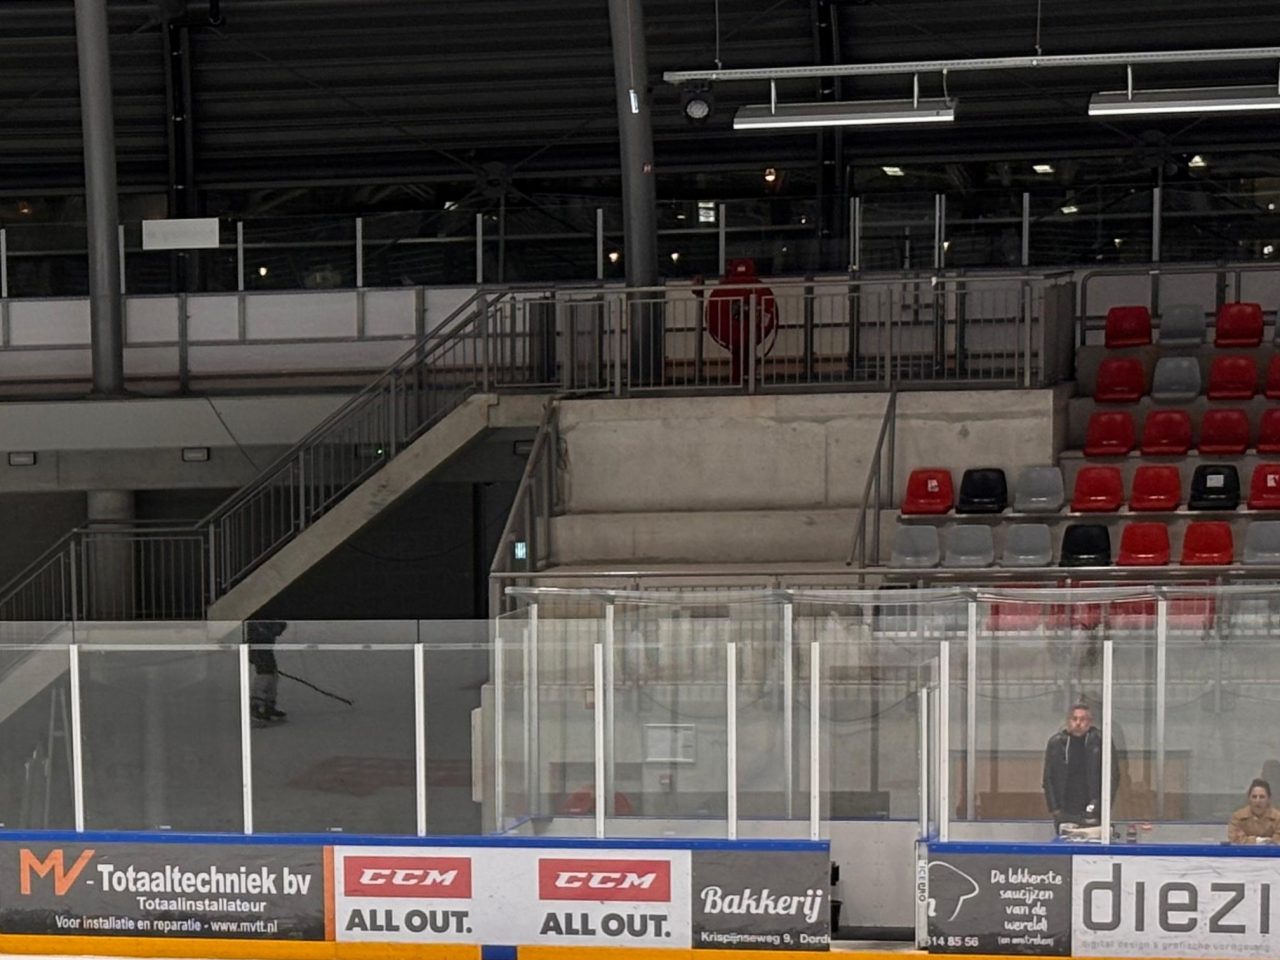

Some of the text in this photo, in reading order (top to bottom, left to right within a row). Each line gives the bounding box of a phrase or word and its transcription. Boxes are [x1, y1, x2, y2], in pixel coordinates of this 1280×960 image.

[97, 864, 277, 894] Totaaltechniek
[282, 867, 311, 895] bv
[359, 868, 459, 886] CCM
[555, 871, 657, 889] CCM
[991, 867, 1062, 885] De lekkerste
[136, 896, 267, 912] Totaalinstallateur
[1000, 886, 1053, 904] saucijzen
[700, 886, 823, 923] Bakkerij
[1005, 901, 1047, 916] van de
[55, 915, 80, 929] Voor
[83, 916, 135, 930] installatie
[137, 919, 151, 931] en
[154, 919, 201, 934] reparatie
[345, 908, 472, 934] ALL OUT.
[539, 912, 671, 938] ALL OUT.
